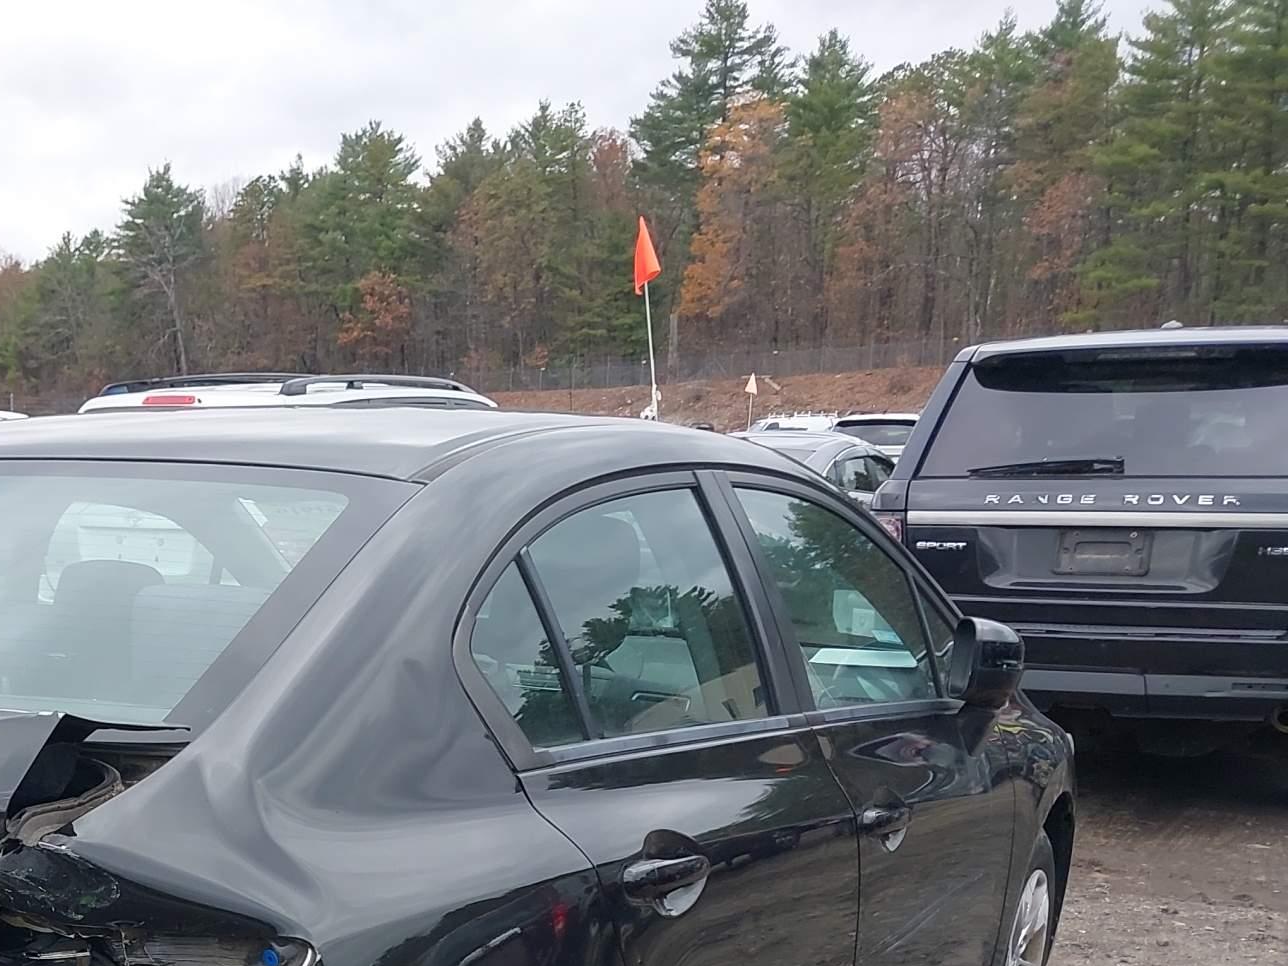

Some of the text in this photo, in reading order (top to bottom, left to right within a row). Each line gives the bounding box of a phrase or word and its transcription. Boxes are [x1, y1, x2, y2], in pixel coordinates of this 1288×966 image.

[983, 494, 1241, 506] RANGE ROVER
[915, 540, 967, 551] SPORT
